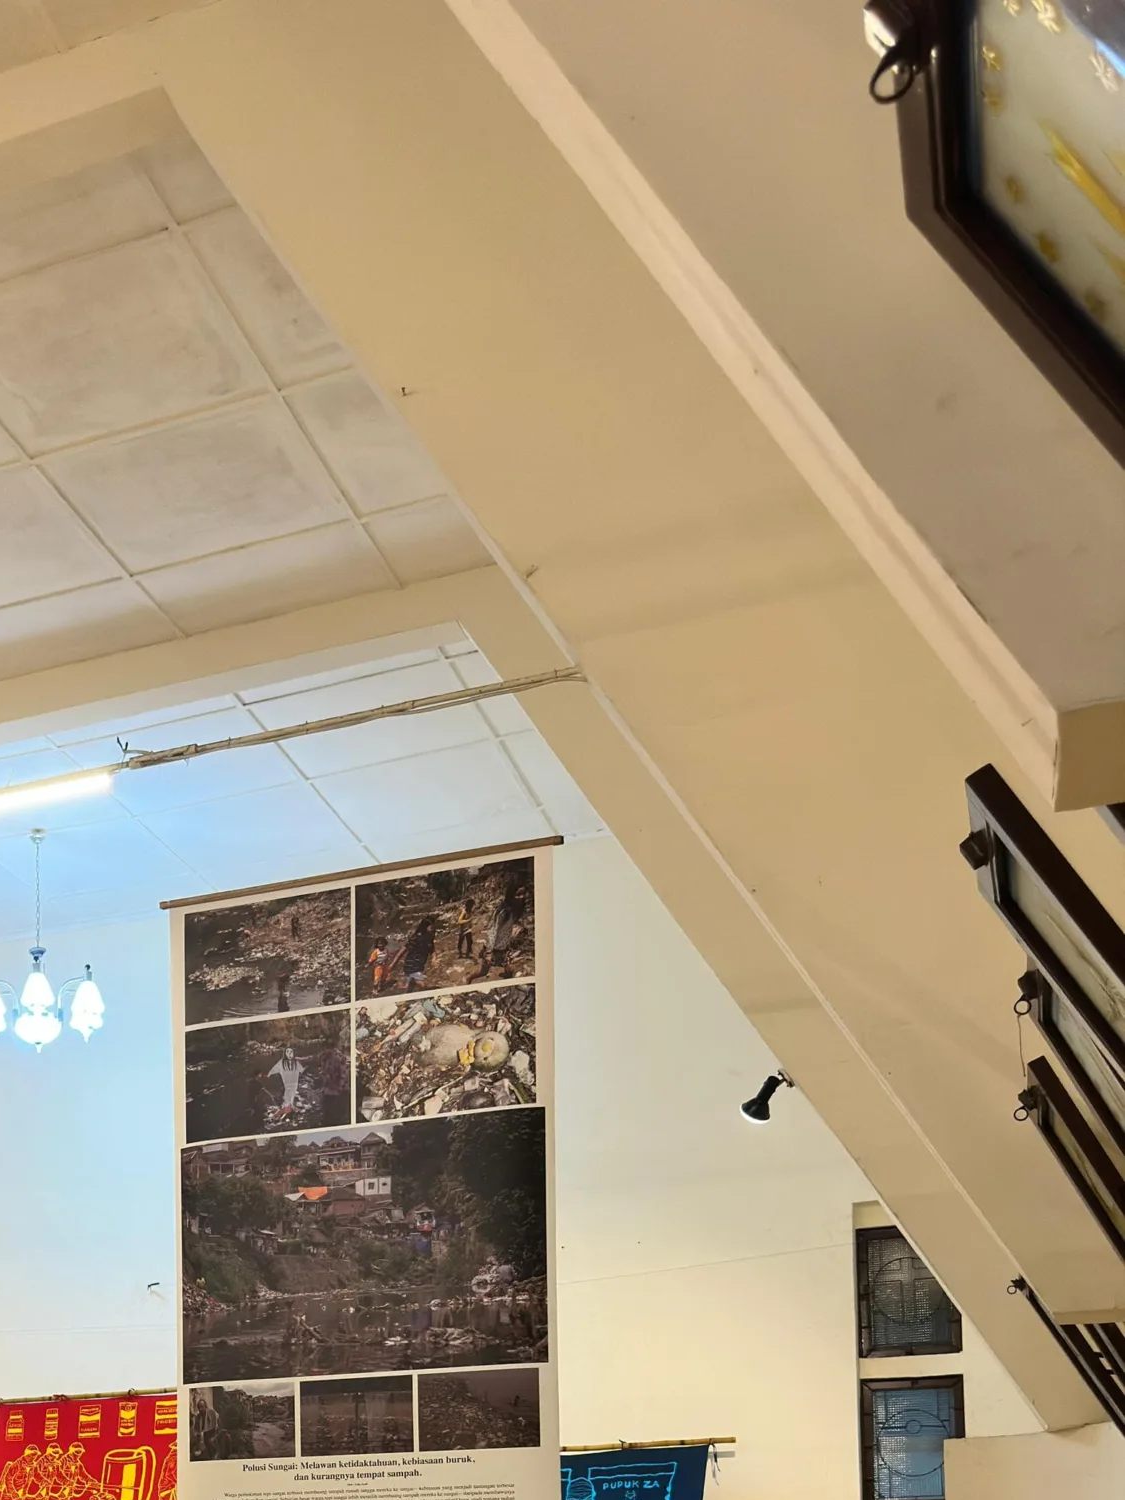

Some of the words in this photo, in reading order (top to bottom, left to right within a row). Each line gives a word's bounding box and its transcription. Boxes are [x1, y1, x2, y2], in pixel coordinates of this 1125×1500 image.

[242, 1464, 266, 1472] Polusi
[267, 1462, 298, 1472] Sungai:
[300, 1460, 337, 1470] Melawan
[338, 1458, 401, 1469] ketidaktahuan,
[402, 1456, 444, 1466] kebiasaan
[446, 1455, 476, 1465] buruk,
[294, 1473, 309, 1481] dan
[311, 1472, 355, 1482] kurangnya
[356, 1470, 385, 1480] tempat
[387, 1469, 422, 1480] sampah.
[602, 1480, 639, 1490] PUPUK
[643, 1480, 660, 1489] ZA
